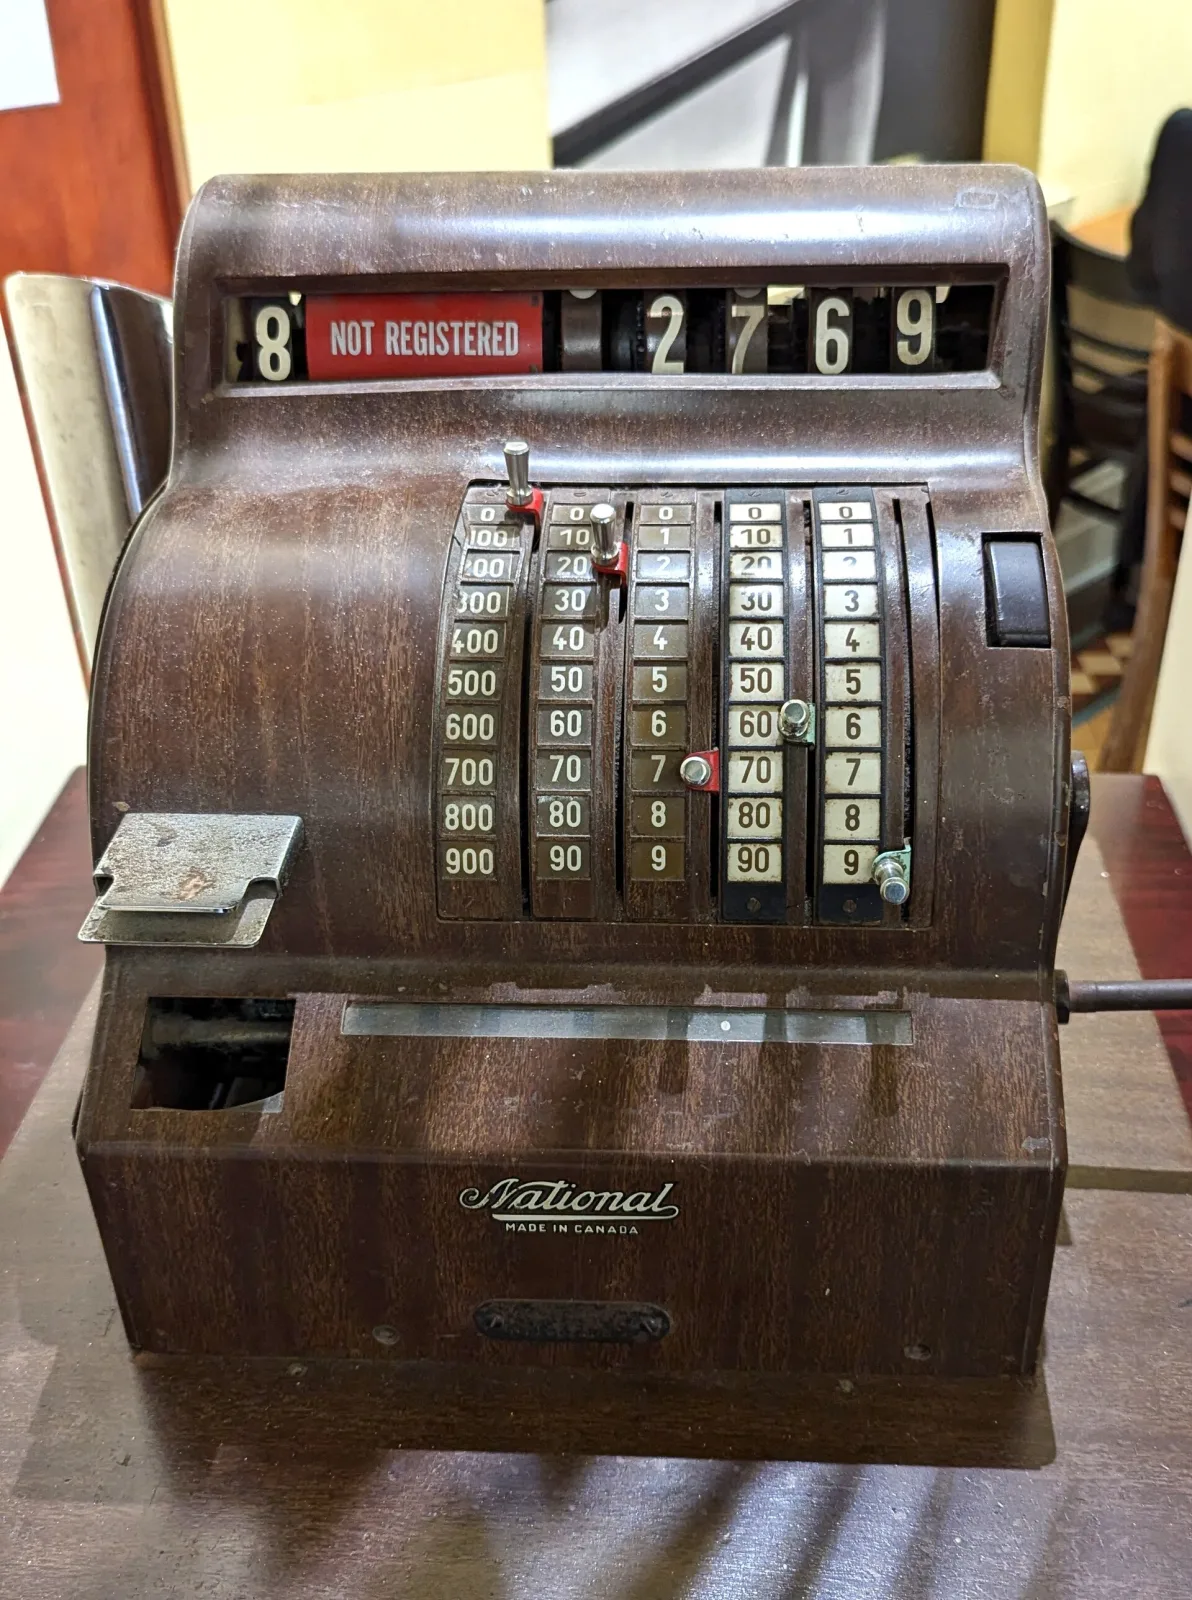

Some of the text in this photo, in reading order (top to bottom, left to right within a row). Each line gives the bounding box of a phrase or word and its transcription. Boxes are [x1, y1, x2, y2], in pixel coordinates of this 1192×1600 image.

[255, 306, 291, 381] 8
[330, 320, 519, 357] NOT REGISTERED
[648, 289, 933, 375] 2 7 6 9
[480, 507, 496, 521] 0
[569, 507, 584, 521] 0
[658, 506, 673, 520] 0
[748, 507, 762, 520] 0
[838, 506, 853, 519] 0
[470, 529, 508, 547] 100
[559, 529, 590, 545] 10
[659, 528, 670, 545] 1
[740, 528, 771, 545] 10
[843, 528, 853, 545] 1
[557, 556, 588, 576] 20
[656, 556, 671, 576] 2
[740, 556, 772, 575] 20
[457, 591, 501, 614] 300
[554, 589, 586, 611] 30
[655, 589, 669, 611] 3
[740, 589, 772, 611] 30
[844, 590, 859, 612] 3
[452, 629, 499, 654] 400
[552, 626, 584, 650] 40
[653, 625, 668, 650] 4
[740, 626, 773, 651] 40
[845, 627, 860, 653] 4
[448, 670, 496, 696] 500
[551, 667, 583, 692] 50
[652, 666, 668, 693] 5
[740, 667, 773, 694] 50
[846, 668, 861, 695] 5
[445, 713, 494, 741] 600
[550, 710, 582, 737] 60
[651, 710, 667, 737] 6
[740, 710, 772, 738] 60
[845, 713, 861, 740] 6
[445, 758, 494, 786] 700
[550, 755, 582, 782] 70
[651, 755, 666, 782] 7
[739, 756, 772, 784] 70
[845, 758, 861, 786] 7
[445, 803, 493, 831] 800
[549, 800, 582, 828] 80
[651, 800, 666, 828] 8
[738, 801, 770, 829] 80
[845, 803, 861, 832] 8
[446, 848, 494, 875] 900
[550, 845, 582, 872] 90
[651, 845, 666, 872] 9
[737, 846, 769, 873] 90
[843, 849, 859, 876] 9
[459, 1178, 680, 1219] National
[505, 1222, 639, 1234] MADE IN CANADA
